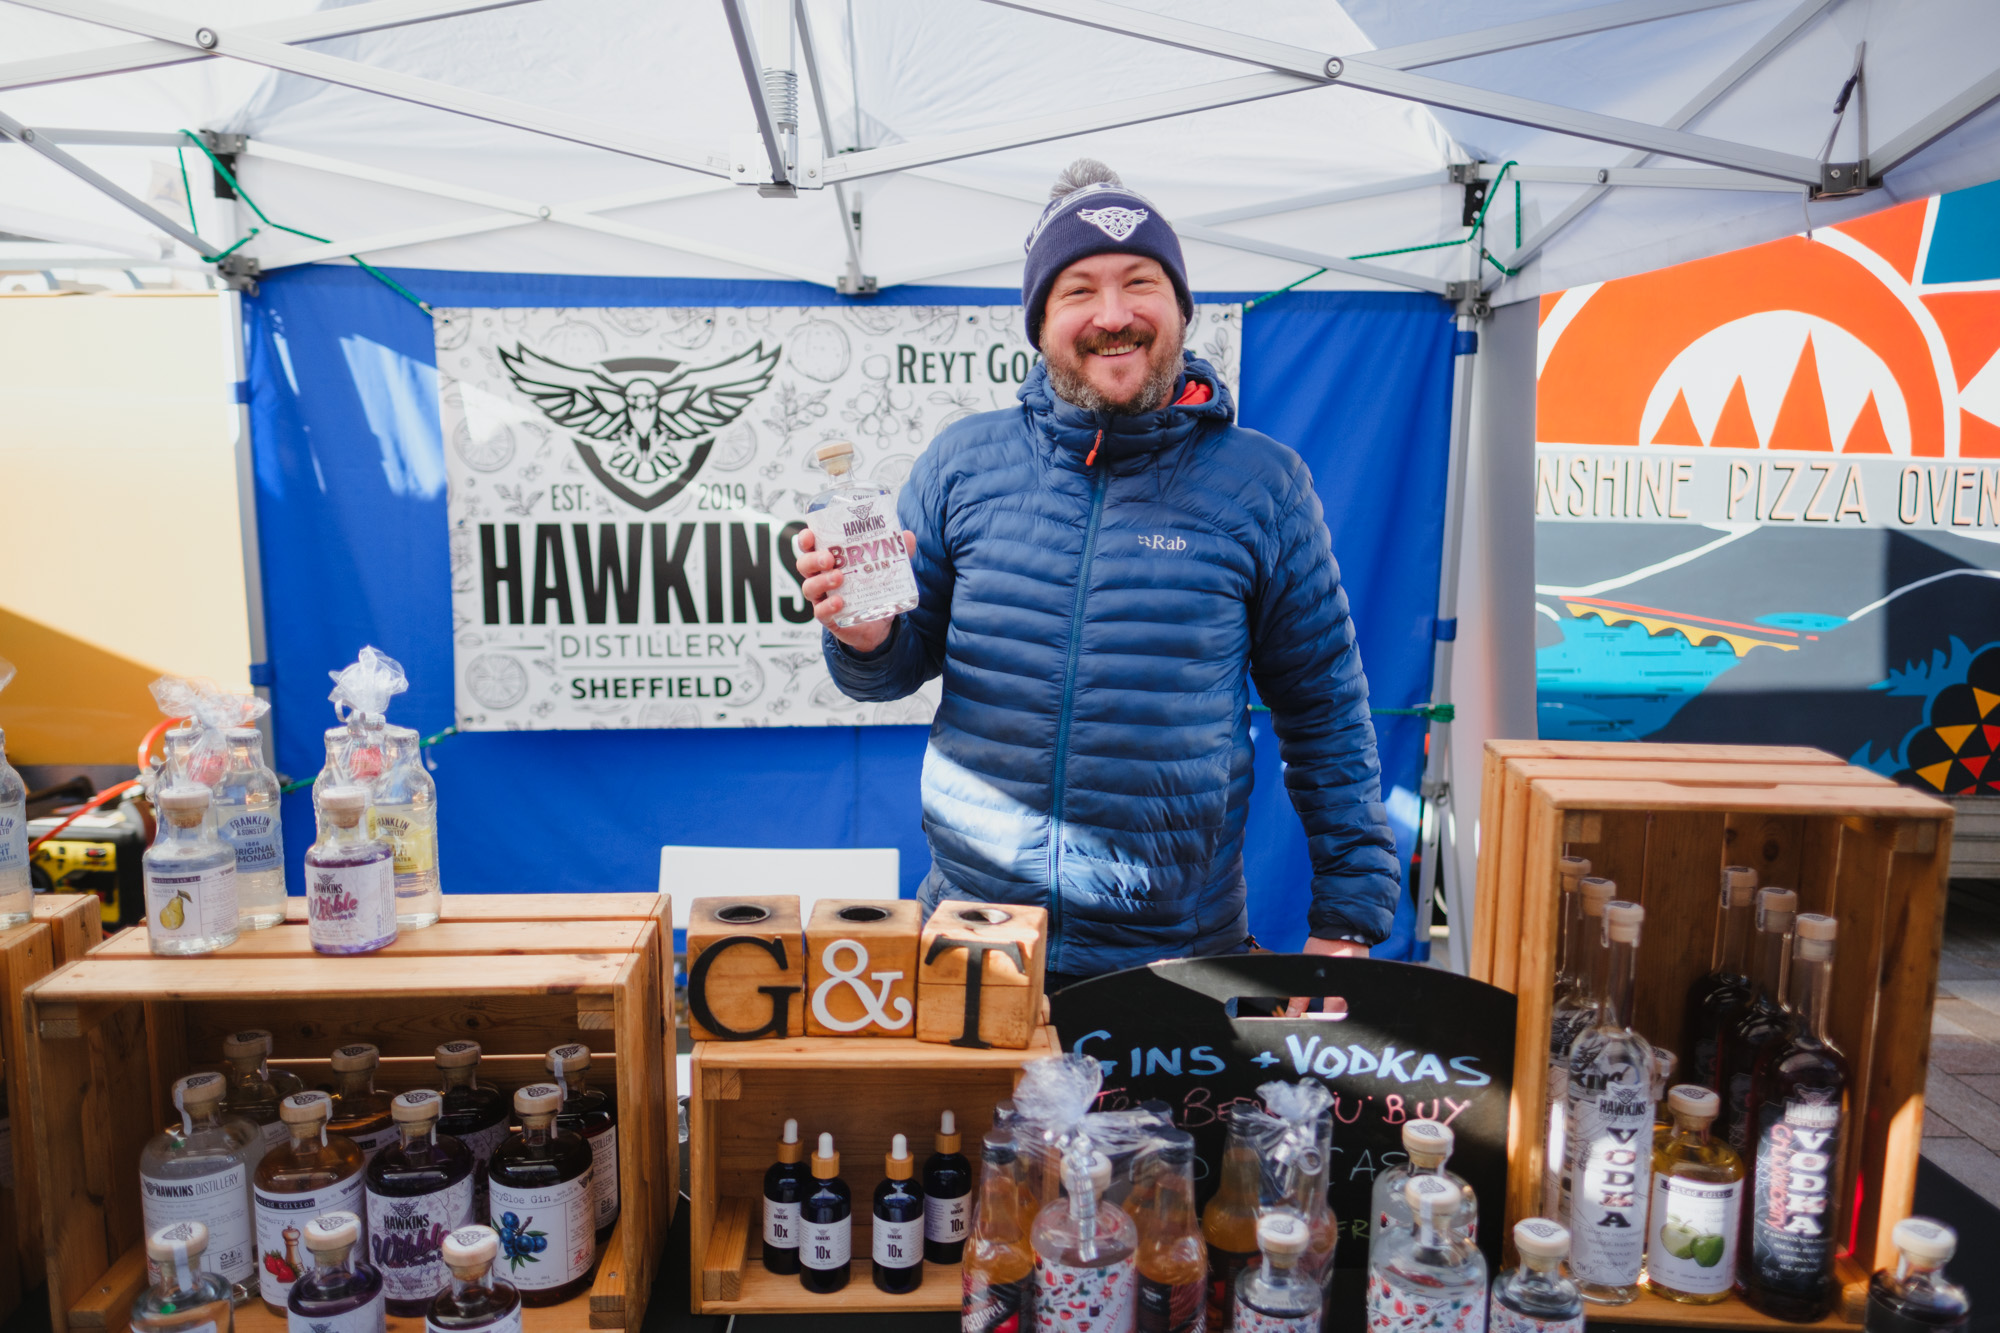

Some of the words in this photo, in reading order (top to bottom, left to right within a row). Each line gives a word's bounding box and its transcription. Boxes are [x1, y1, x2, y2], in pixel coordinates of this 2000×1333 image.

[897, 343, 976, 384] REYT
[987, 343, 1043, 384] GO
[552, 484, 590, 511] EST:
[698, 483, 746, 511] 2019
[1727, 462, 1869, 524] PIZZA
[1898, 466, 2000, 528] OVEN
[843, 515, 886, 537] HAWKINS
[846, 531, 888, 544] DISTILLERY
[1151, 534, 1187, 551] Rab
[828, 531, 906, 571] BRYN'S
[479, 521, 816, 625] HAWKINS
[863, 560, 891, 573] GIN
[560, 634, 747, 659] DISTILLERY
[571, 677, 732, 699] SHEFFIELD
[230, 815, 271, 830] FRANKLIN
[236, 851, 276, 863] MONADE
[314, 883, 343, 894] HAWKINS
[688, 935, 801, 1041] G
[811, 939, 913, 1032] &
[924, 934, 1026, 1049] T
[1286, 1034, 1492, 1087] VODKAS
[1383, 1094, 1472, 1125] BUY
[1600, 1099, 1646, 1116] HAWKINS
[591, 1133, 613, 1151] ISTILLERY
[156, 1184, 194, 1197] HAWKINS
[196, 1172, 240, 1196] DISTILLERY
[1596, 1126, 1639, 1229] VODKA
[1782, 1129, 1832, 1234] VODKA
[278, 1198, 316, 1210] Edition
[530, 1195, 551, 1204] Gin
[384, 1214, 430, 1230] HAWKINS
[773, 1223, 789, 1239] 10x
[950, 1218, 965, 1233] 10x
[814, 1245, 831, 1260] 10x
[886, 1243, 903, 1259] 10x
